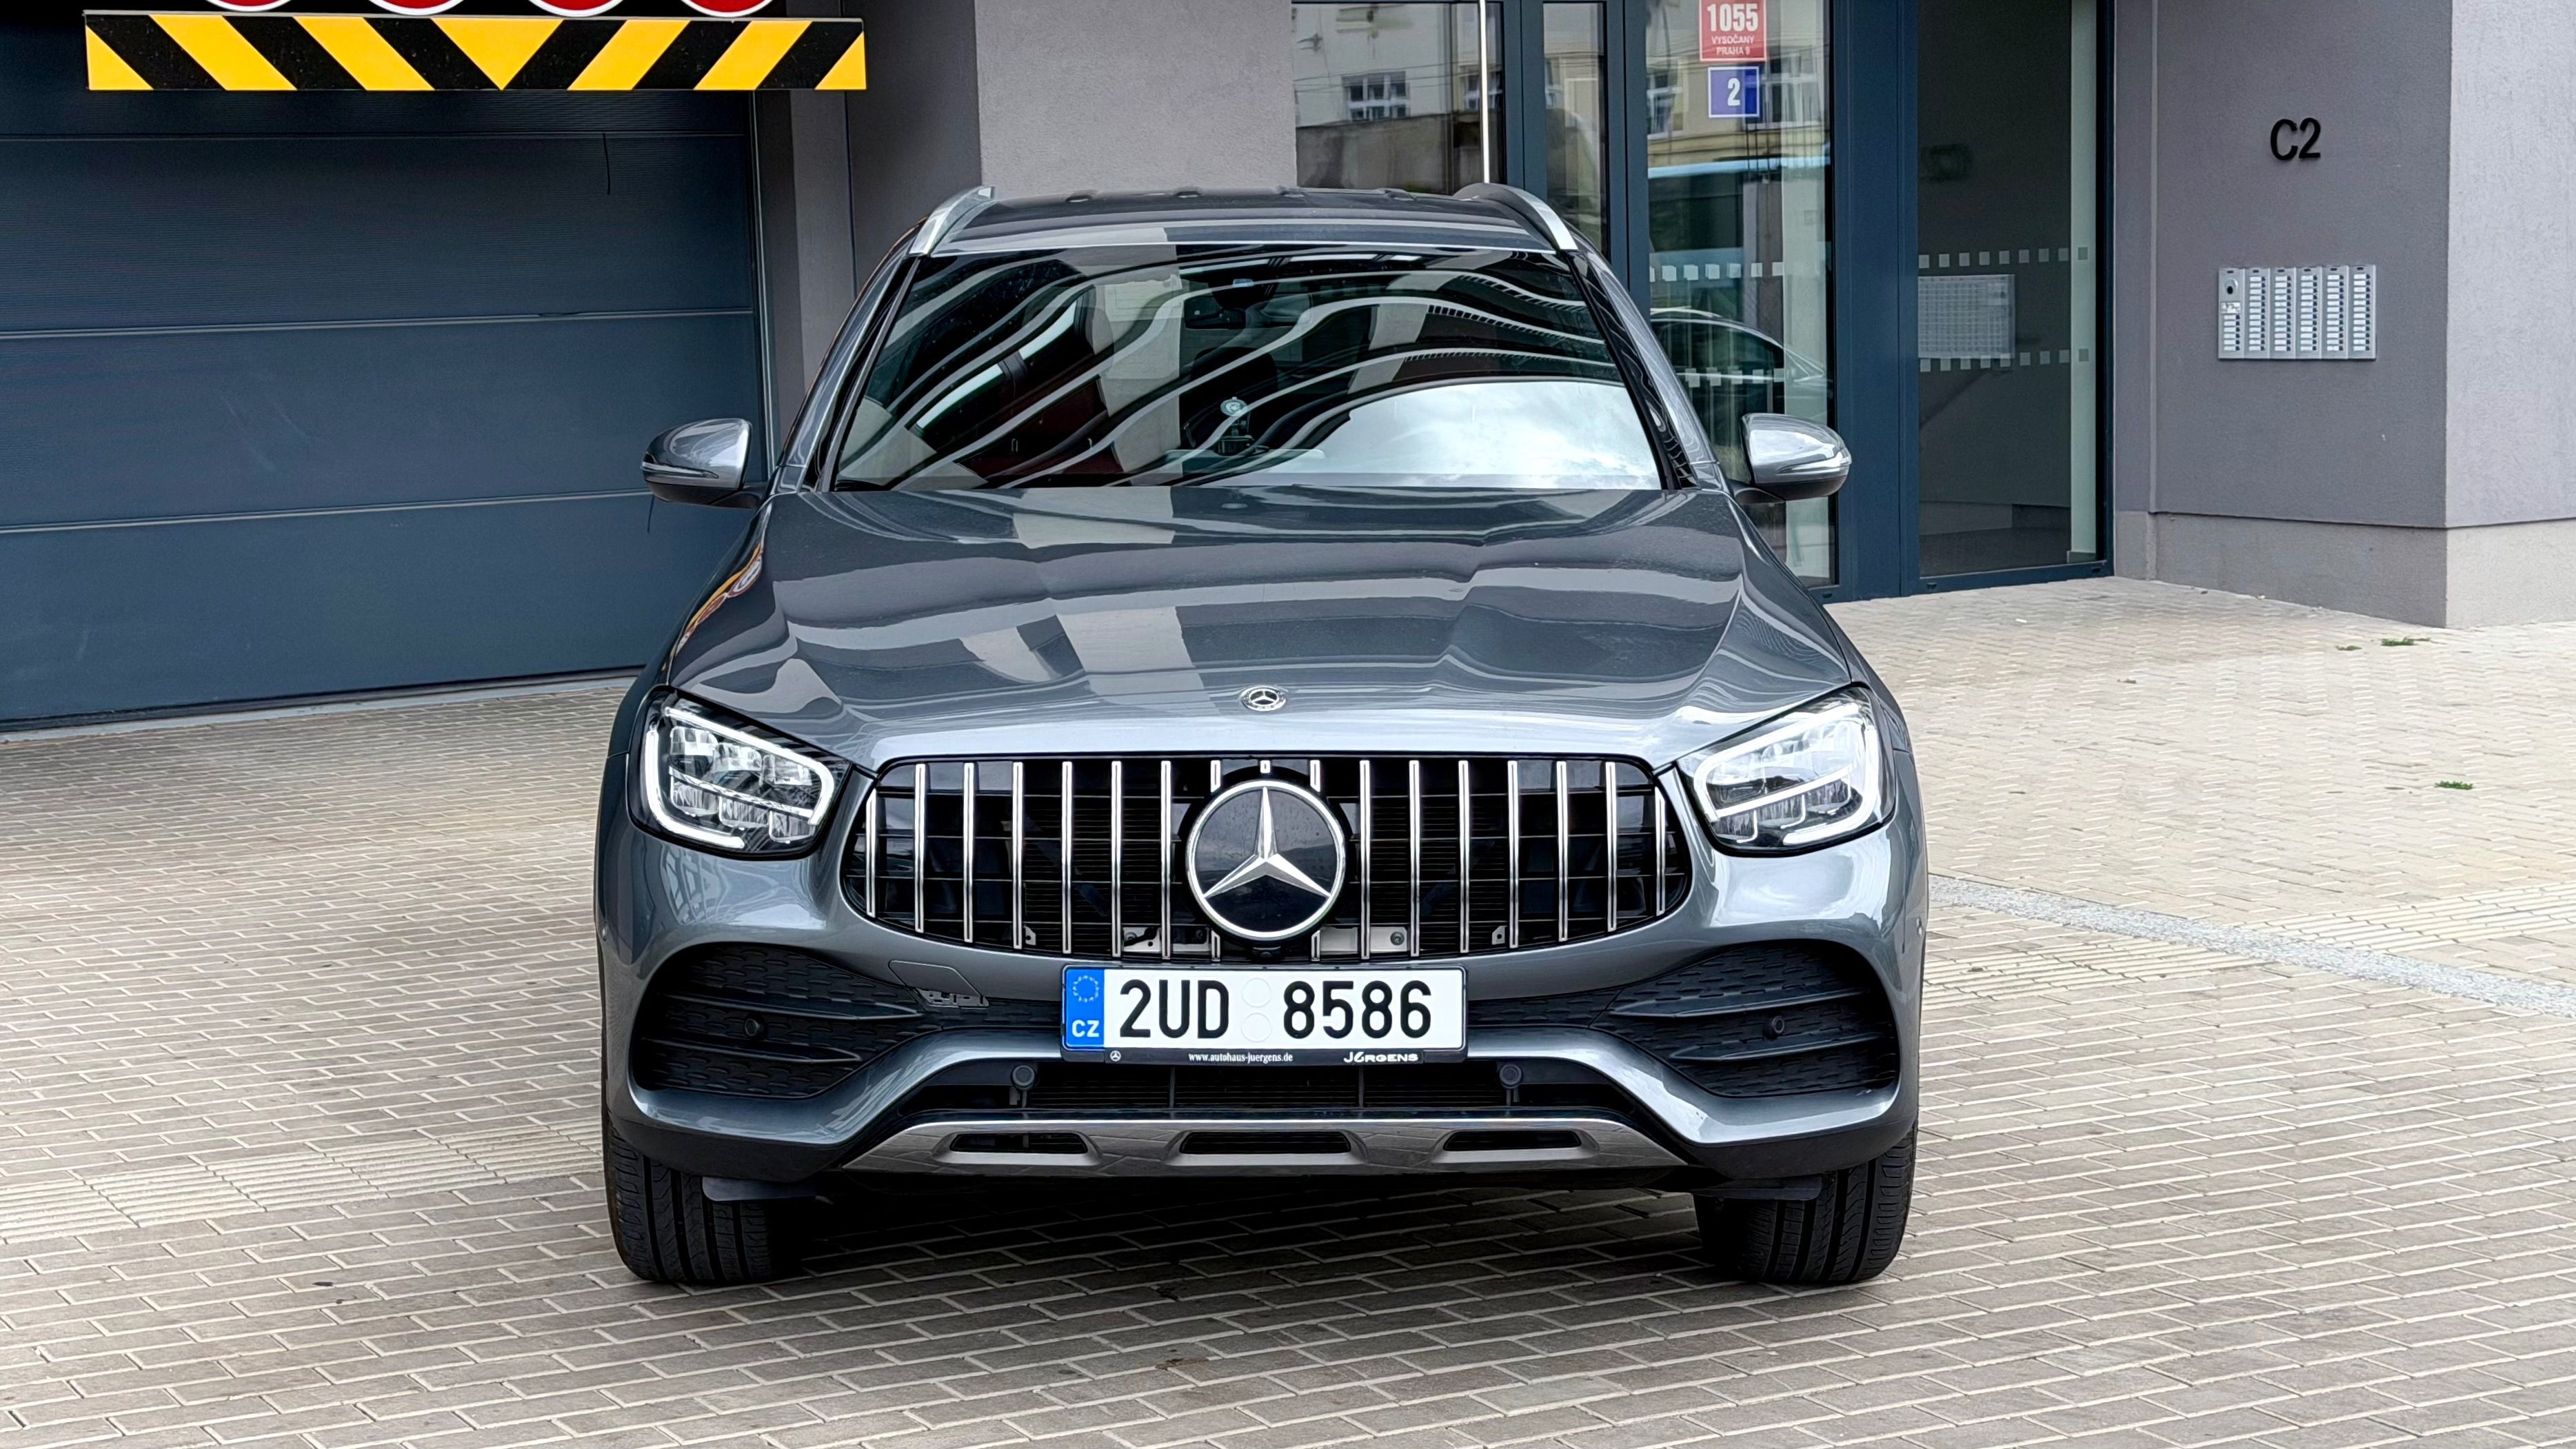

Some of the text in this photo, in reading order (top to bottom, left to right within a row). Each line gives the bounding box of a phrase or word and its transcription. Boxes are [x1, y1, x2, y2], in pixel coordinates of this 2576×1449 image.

[1707, 3, 1758, 32] 1055
[1711, 34, 1754, 44] VYSOČANY
[1716, 46, 1744, 55] PRAHA
[1727, 78, 1740, 106] 2
[2270, 118, 2321, 160] C2
[1119, 979, 1431, 1039] 2UD 8586
[1071, 1019, 1100, 1037] CZ
[1188, 1052, 1293, 1064] www.autohaus-juergens.de
